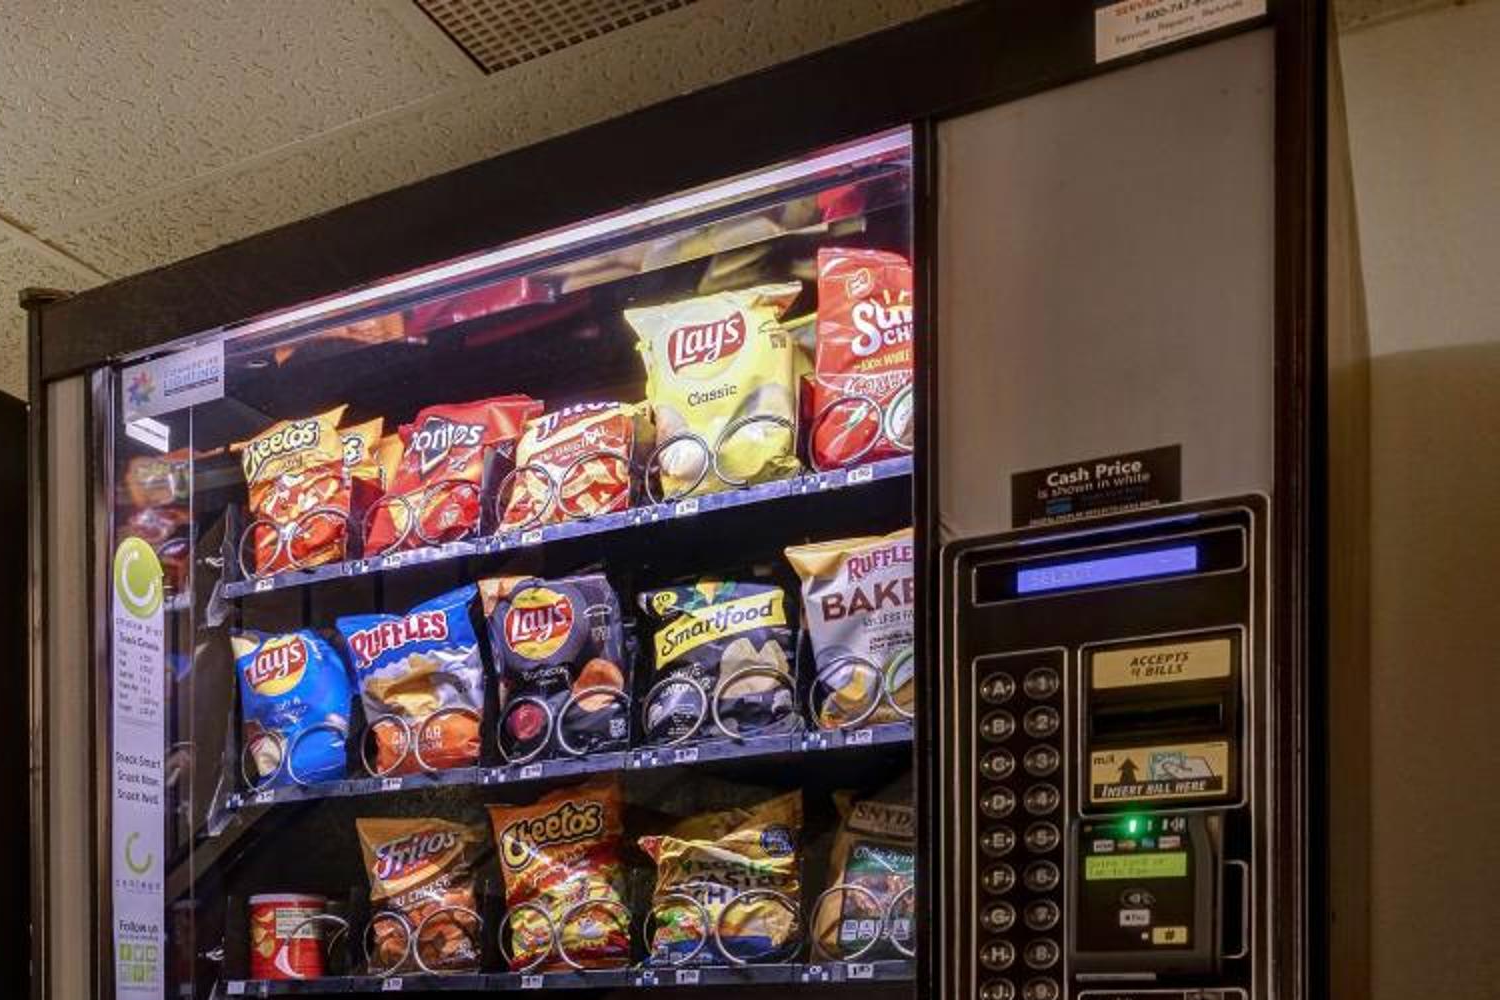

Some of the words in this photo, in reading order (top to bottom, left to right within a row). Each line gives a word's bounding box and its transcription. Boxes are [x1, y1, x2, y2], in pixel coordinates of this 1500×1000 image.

[687, 384, 737, 406] Classic
[1037, 486, 1049, 499] is
[1051, 480, 1095, 498] shown
[1097, 476, 1111, 490] in
[1115, 471, 1152, 486] white
[1046, 466, 1090, 489] Cash
[1095, 458, 1143, 482] Price
[351, 610, 447, 668] RUFFLES
[661, 603, 773, 657] Smartfood
[1130, 651, 1189, 667] ACCEPTS
[1144, 664, 1184, 677] BILLS
[1101, 782, 1144, 798] INSERT
[502, 801, 603, 870] Cheetos
[375, 830, 460, 880] Fritos
[119, 919, 146, 933] Follow
